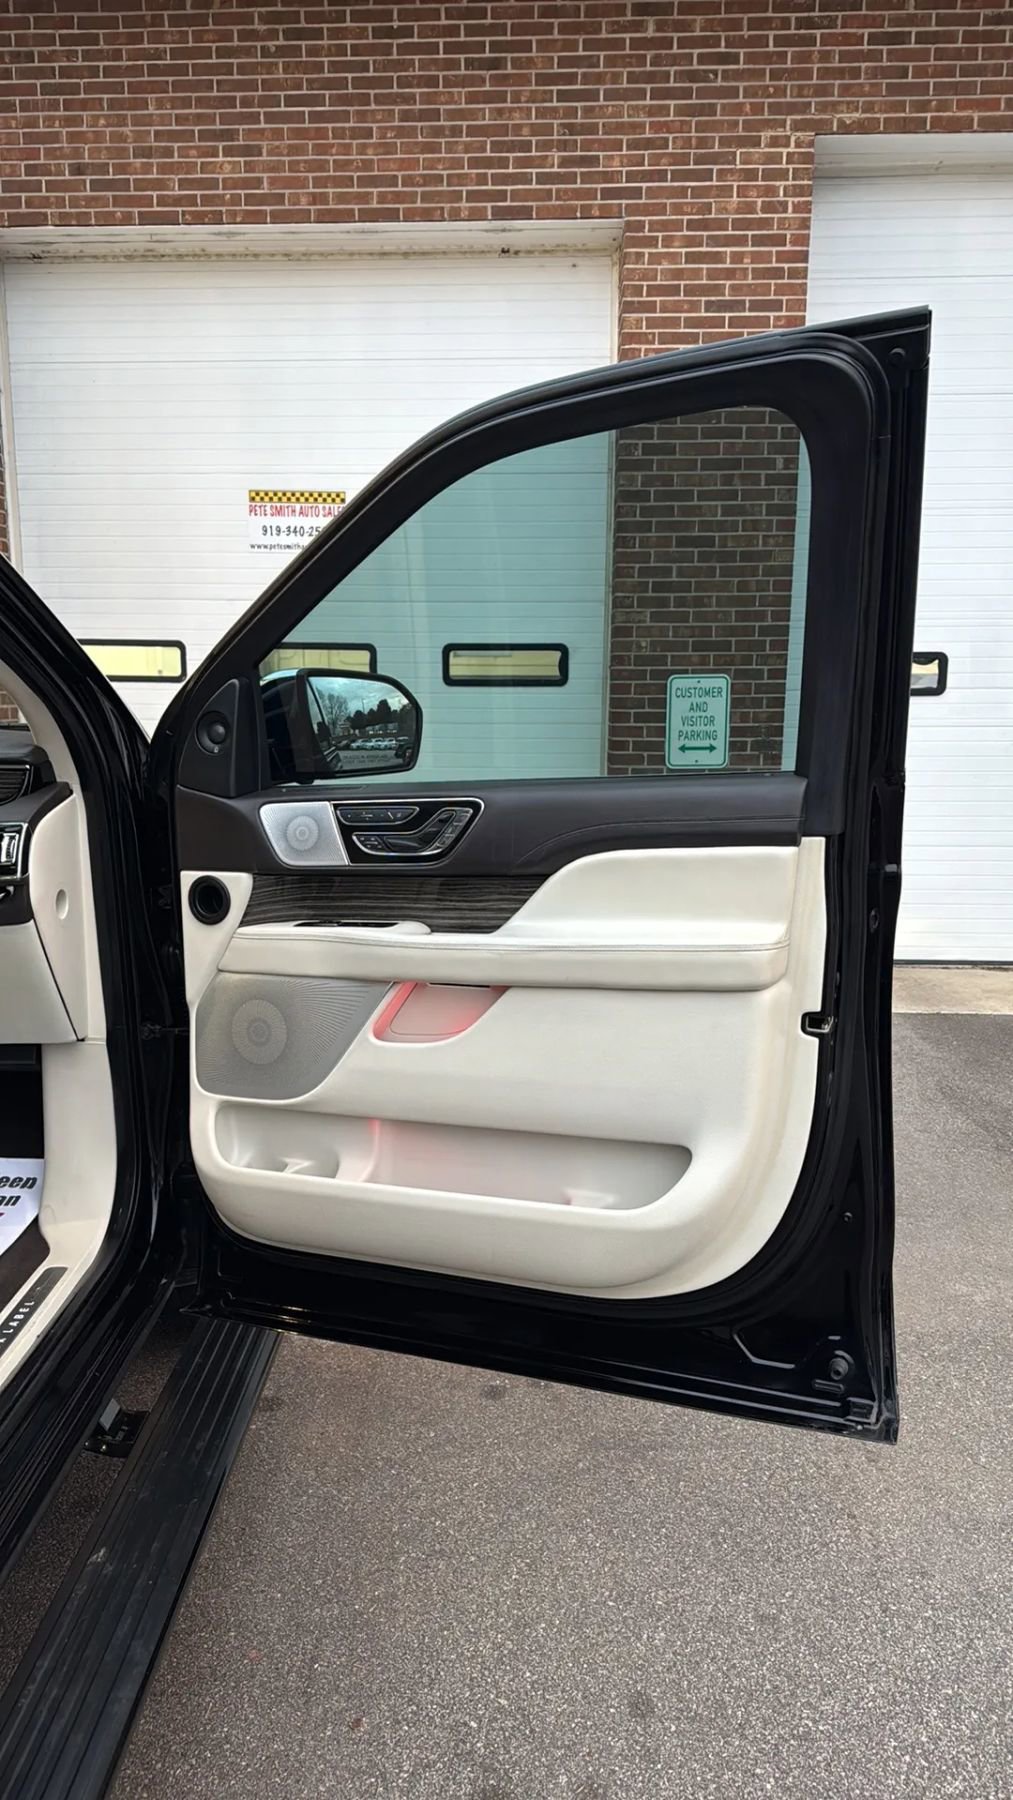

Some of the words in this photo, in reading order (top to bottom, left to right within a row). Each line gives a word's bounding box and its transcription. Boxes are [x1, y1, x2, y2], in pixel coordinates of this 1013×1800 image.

[249, 504, 268, 517] PETE
[269, 505, 297, 517] SMITH
[298, 505, 320, 518] AUTO
[322, 505, 345, 518] SALE
[262, 525, 321, 537] 919-340-25
[675, 686, 723, 698] CUSTOMER
[689, 701, 708, 713] AND
[681, 715, 716, 727] VISITOR
[678, 729, 718, 741] PARKING
[2, 1301, 35, 1334] LABEL
